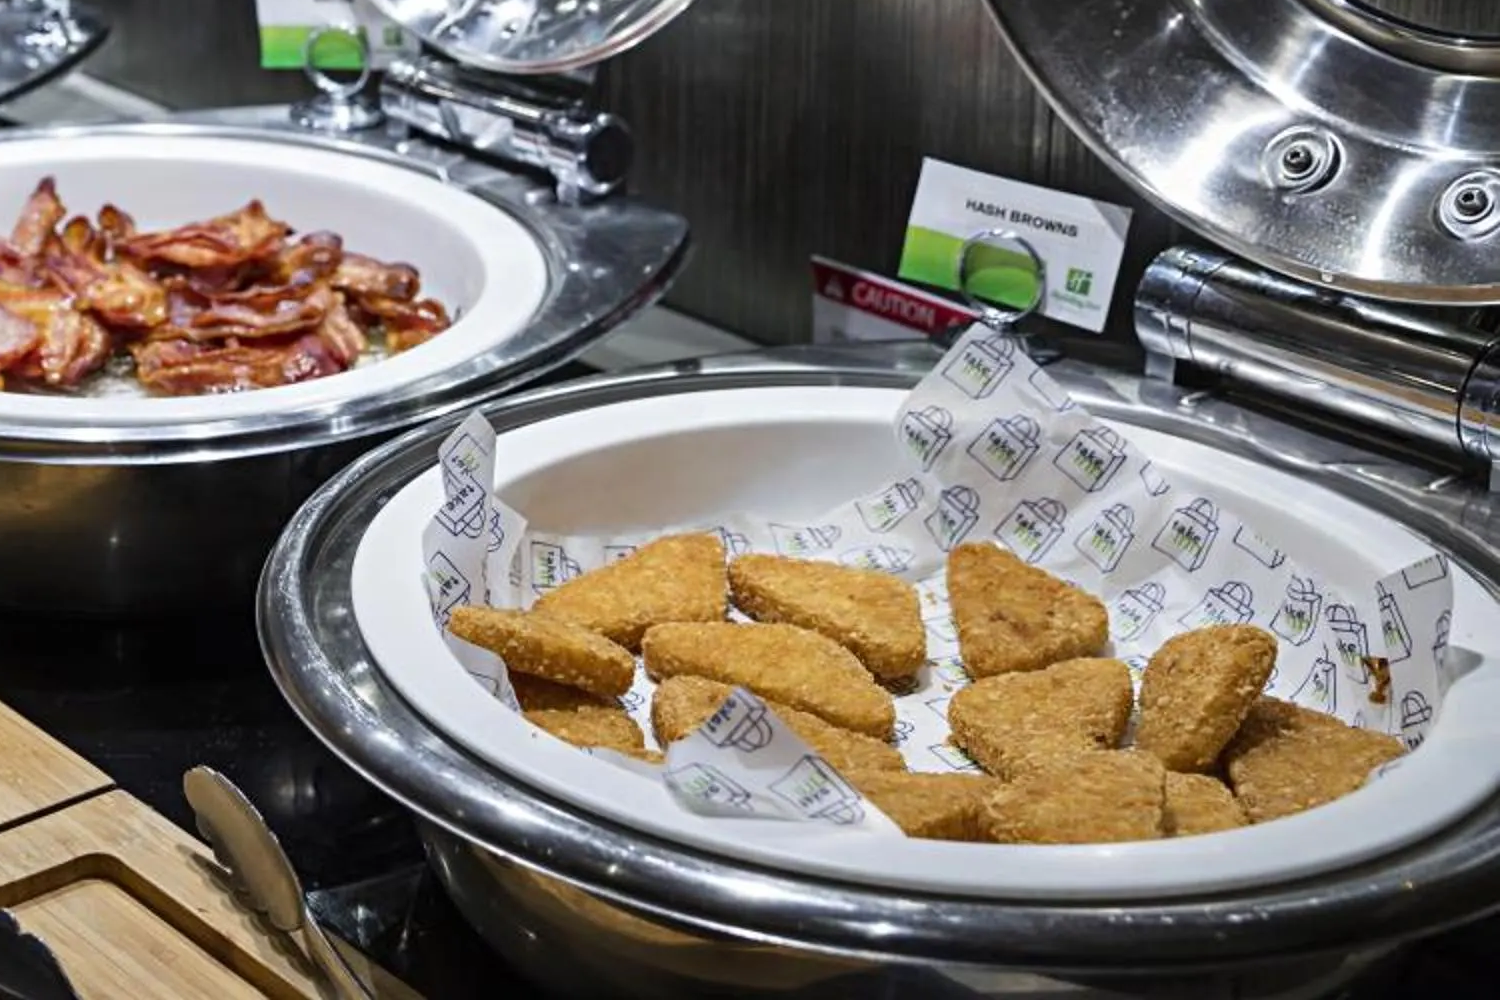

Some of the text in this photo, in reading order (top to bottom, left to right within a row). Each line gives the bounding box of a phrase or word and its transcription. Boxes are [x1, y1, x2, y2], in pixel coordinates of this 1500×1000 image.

[965, 198, 1078, 237] HASH BROWNS
[852, 280, 936, 328] CAUTION
[446, 484, 475, 511] take
